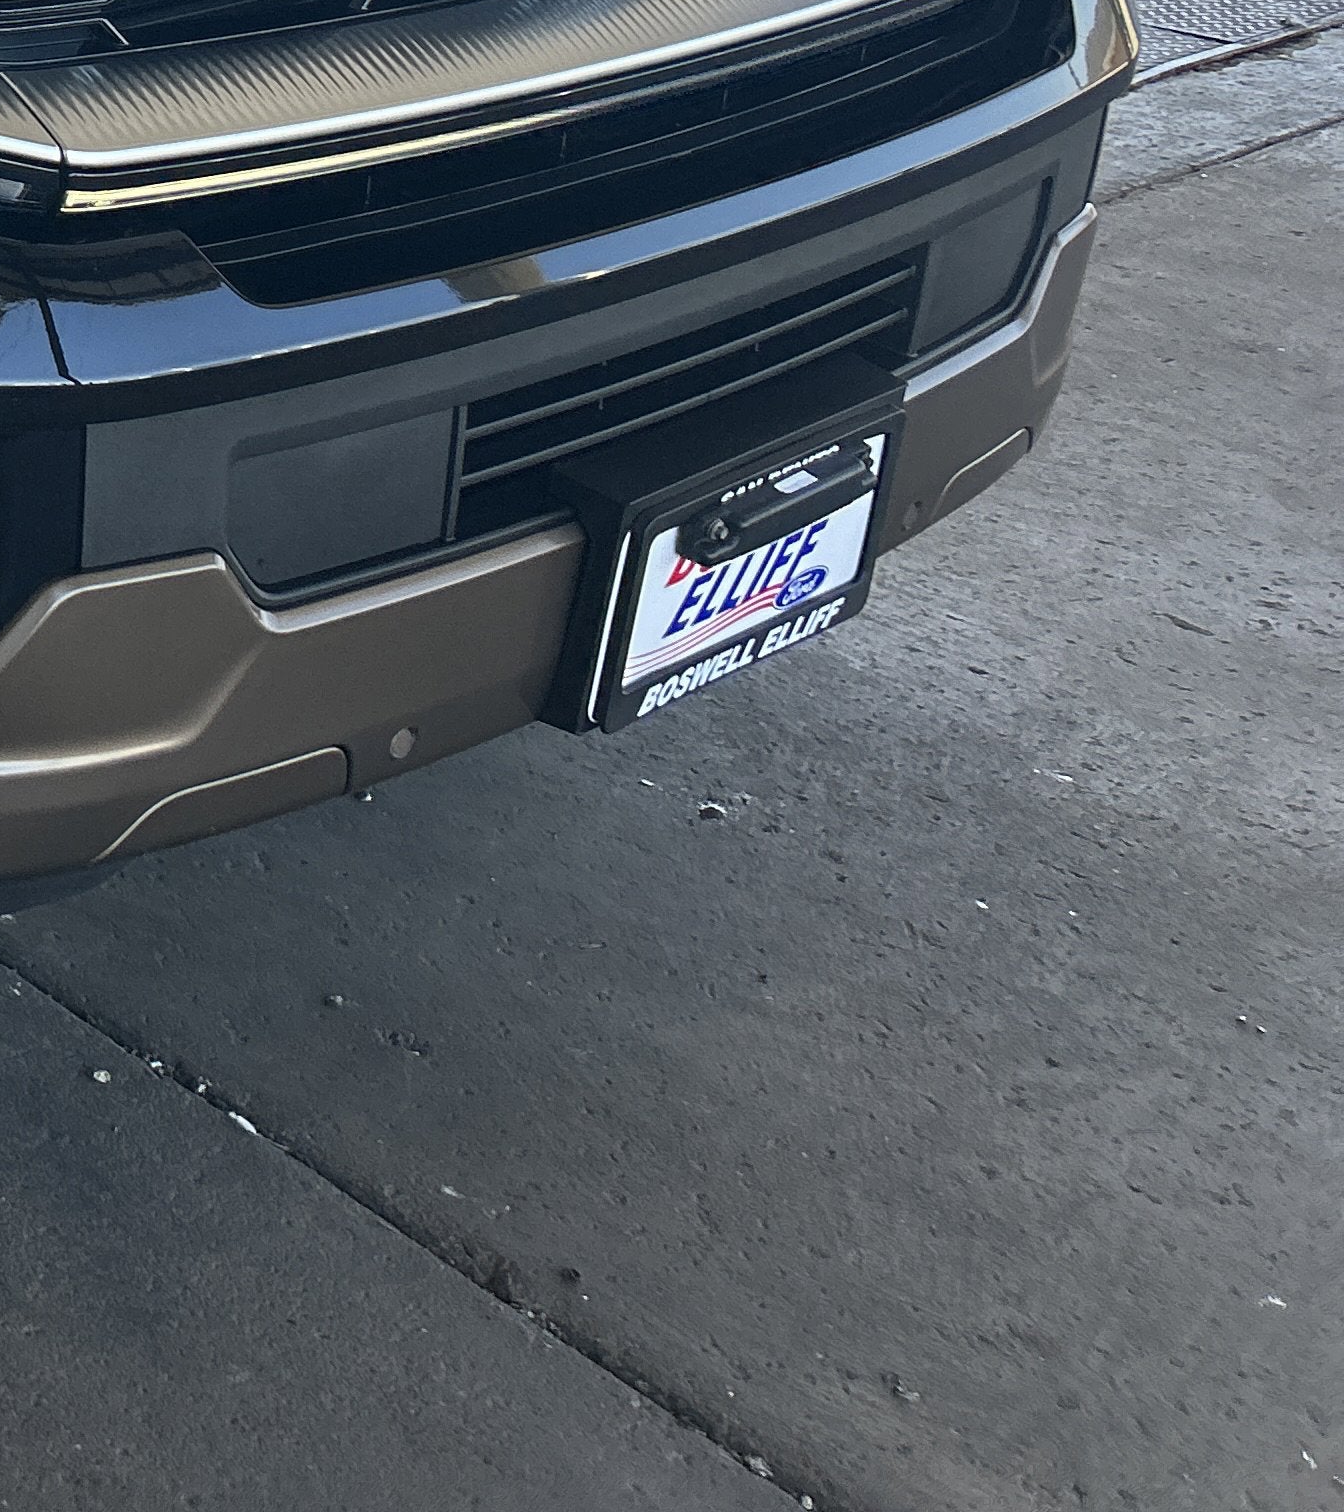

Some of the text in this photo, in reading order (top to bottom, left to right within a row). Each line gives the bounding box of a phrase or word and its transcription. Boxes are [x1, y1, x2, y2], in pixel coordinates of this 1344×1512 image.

[662, 519, 829, 638] ELLIFF
[636, 597, 846, 718] BOSWELL ELLIFF
